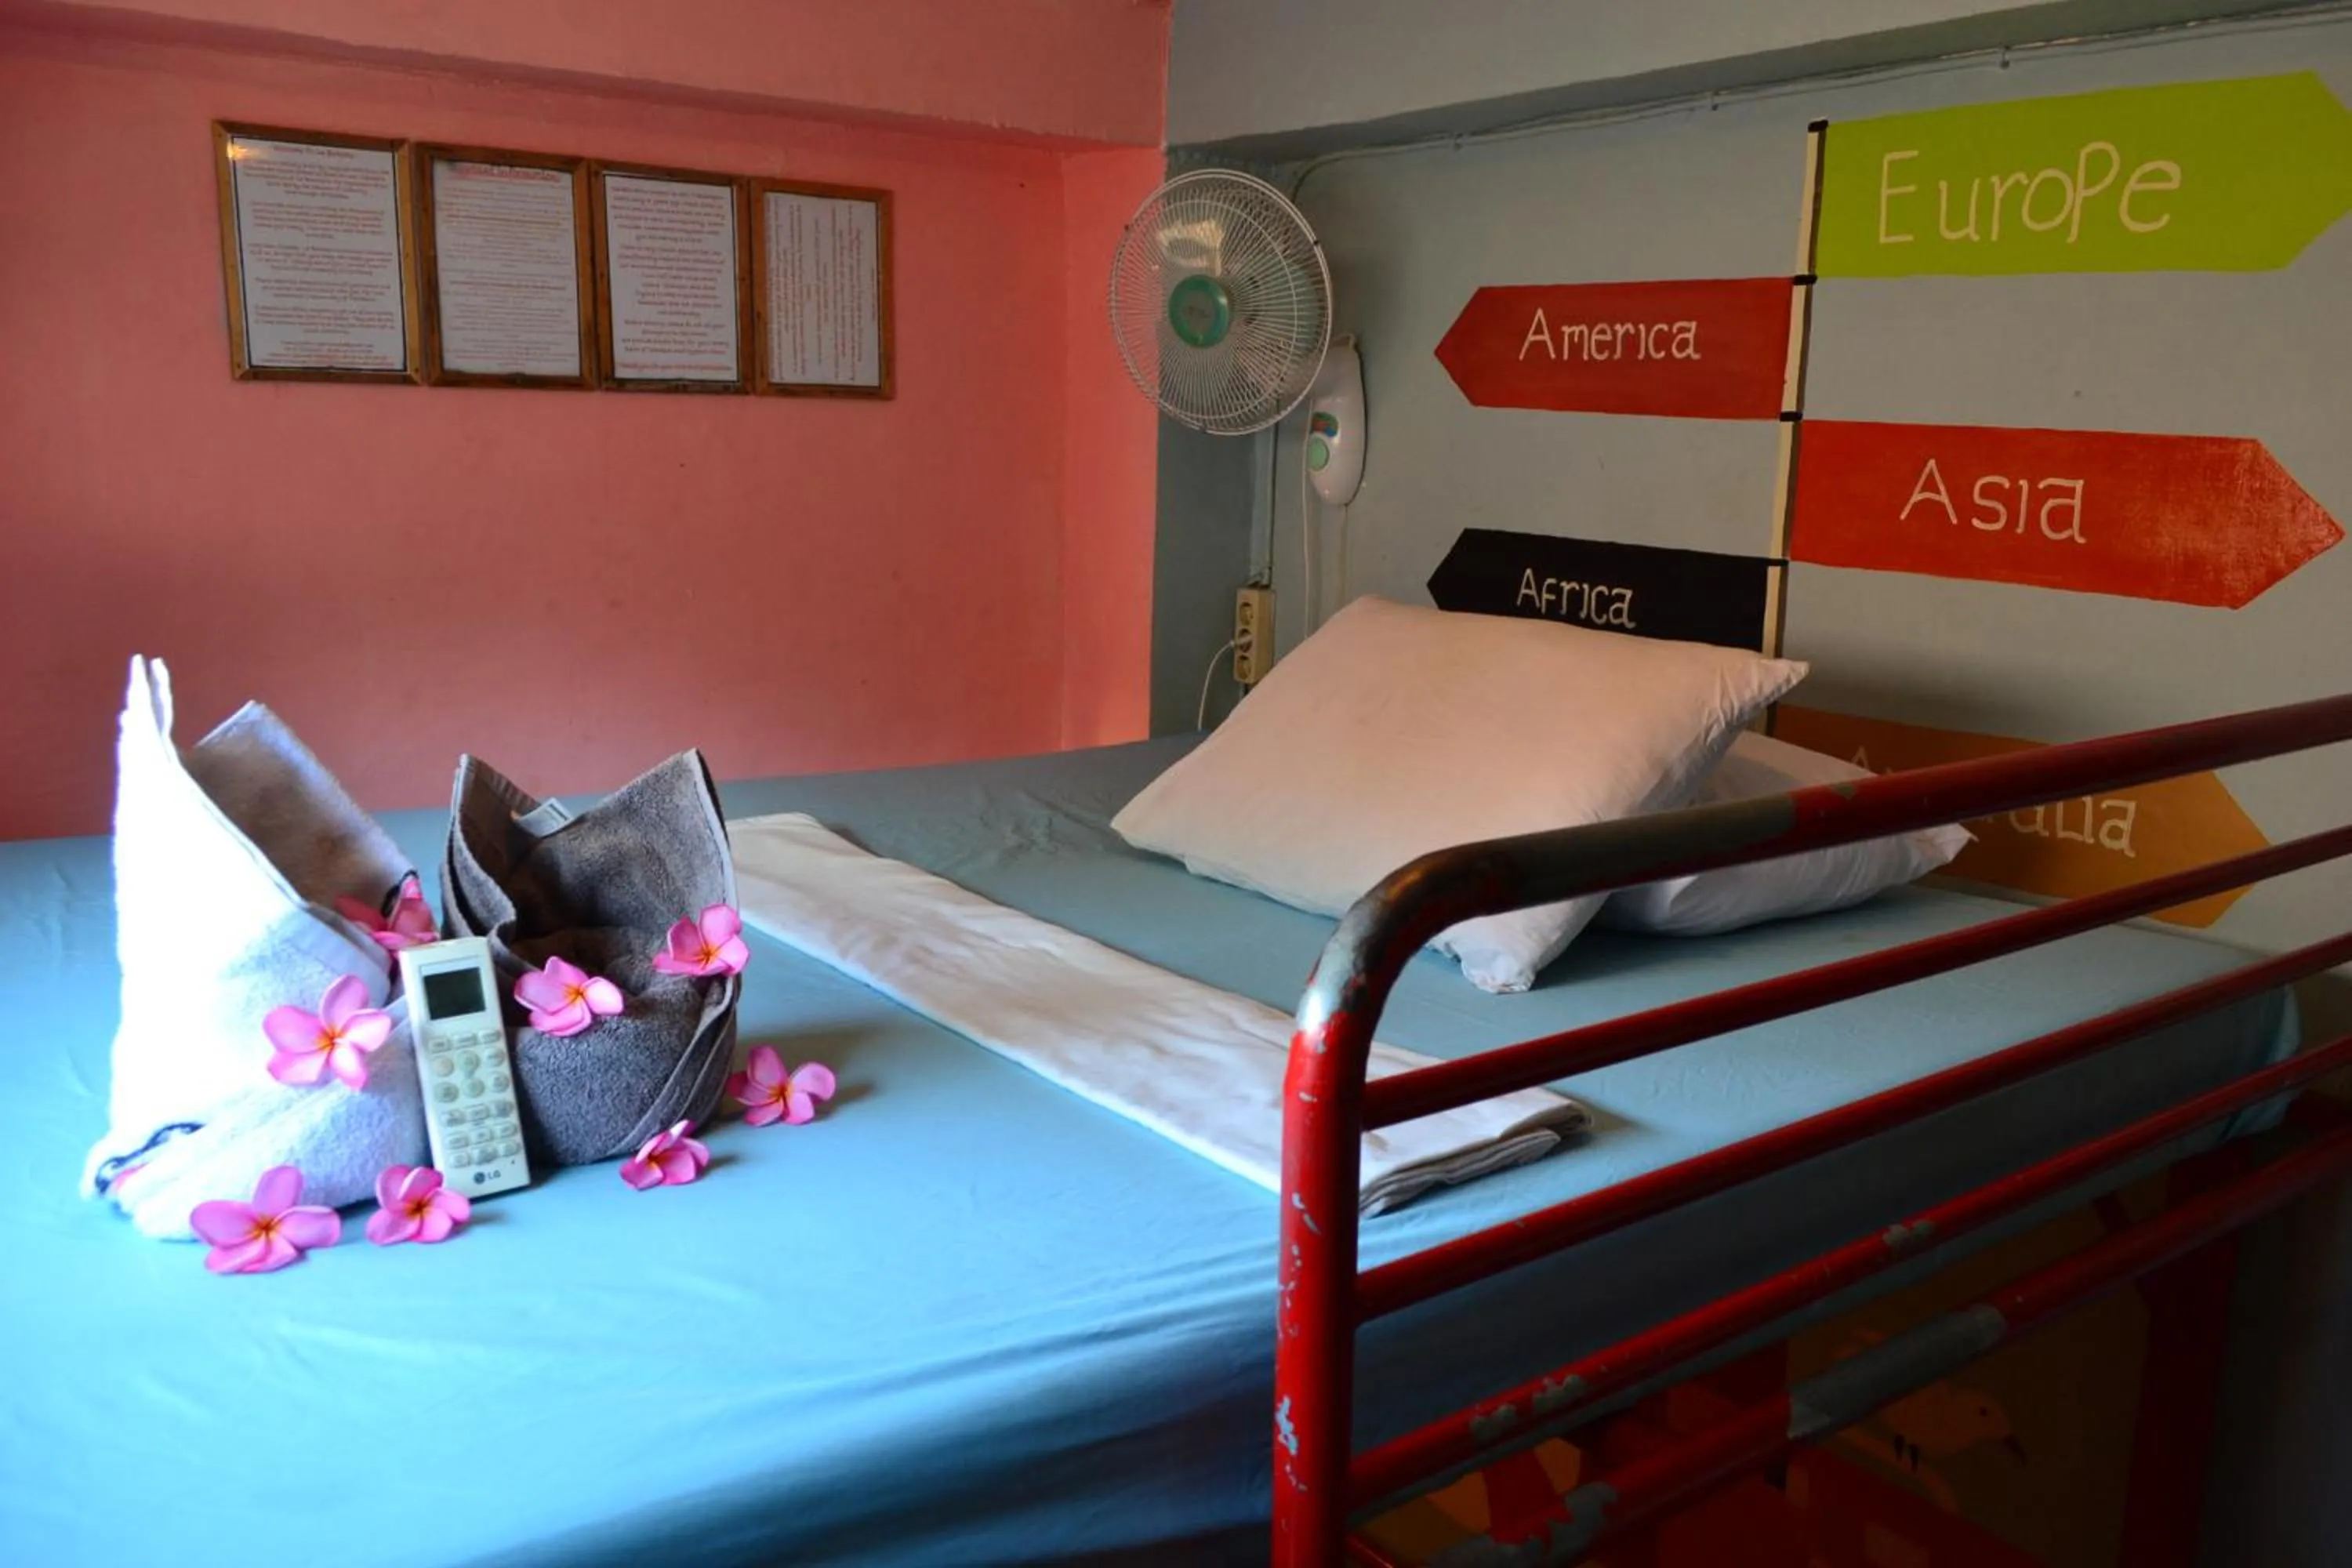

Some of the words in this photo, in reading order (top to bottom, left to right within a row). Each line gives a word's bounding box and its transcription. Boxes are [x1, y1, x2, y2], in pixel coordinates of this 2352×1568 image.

[1519, 307, 1701, 361] America
[1899, 458, 2087, 544] Asia
[1516, 568, 1636, 629] Africa
